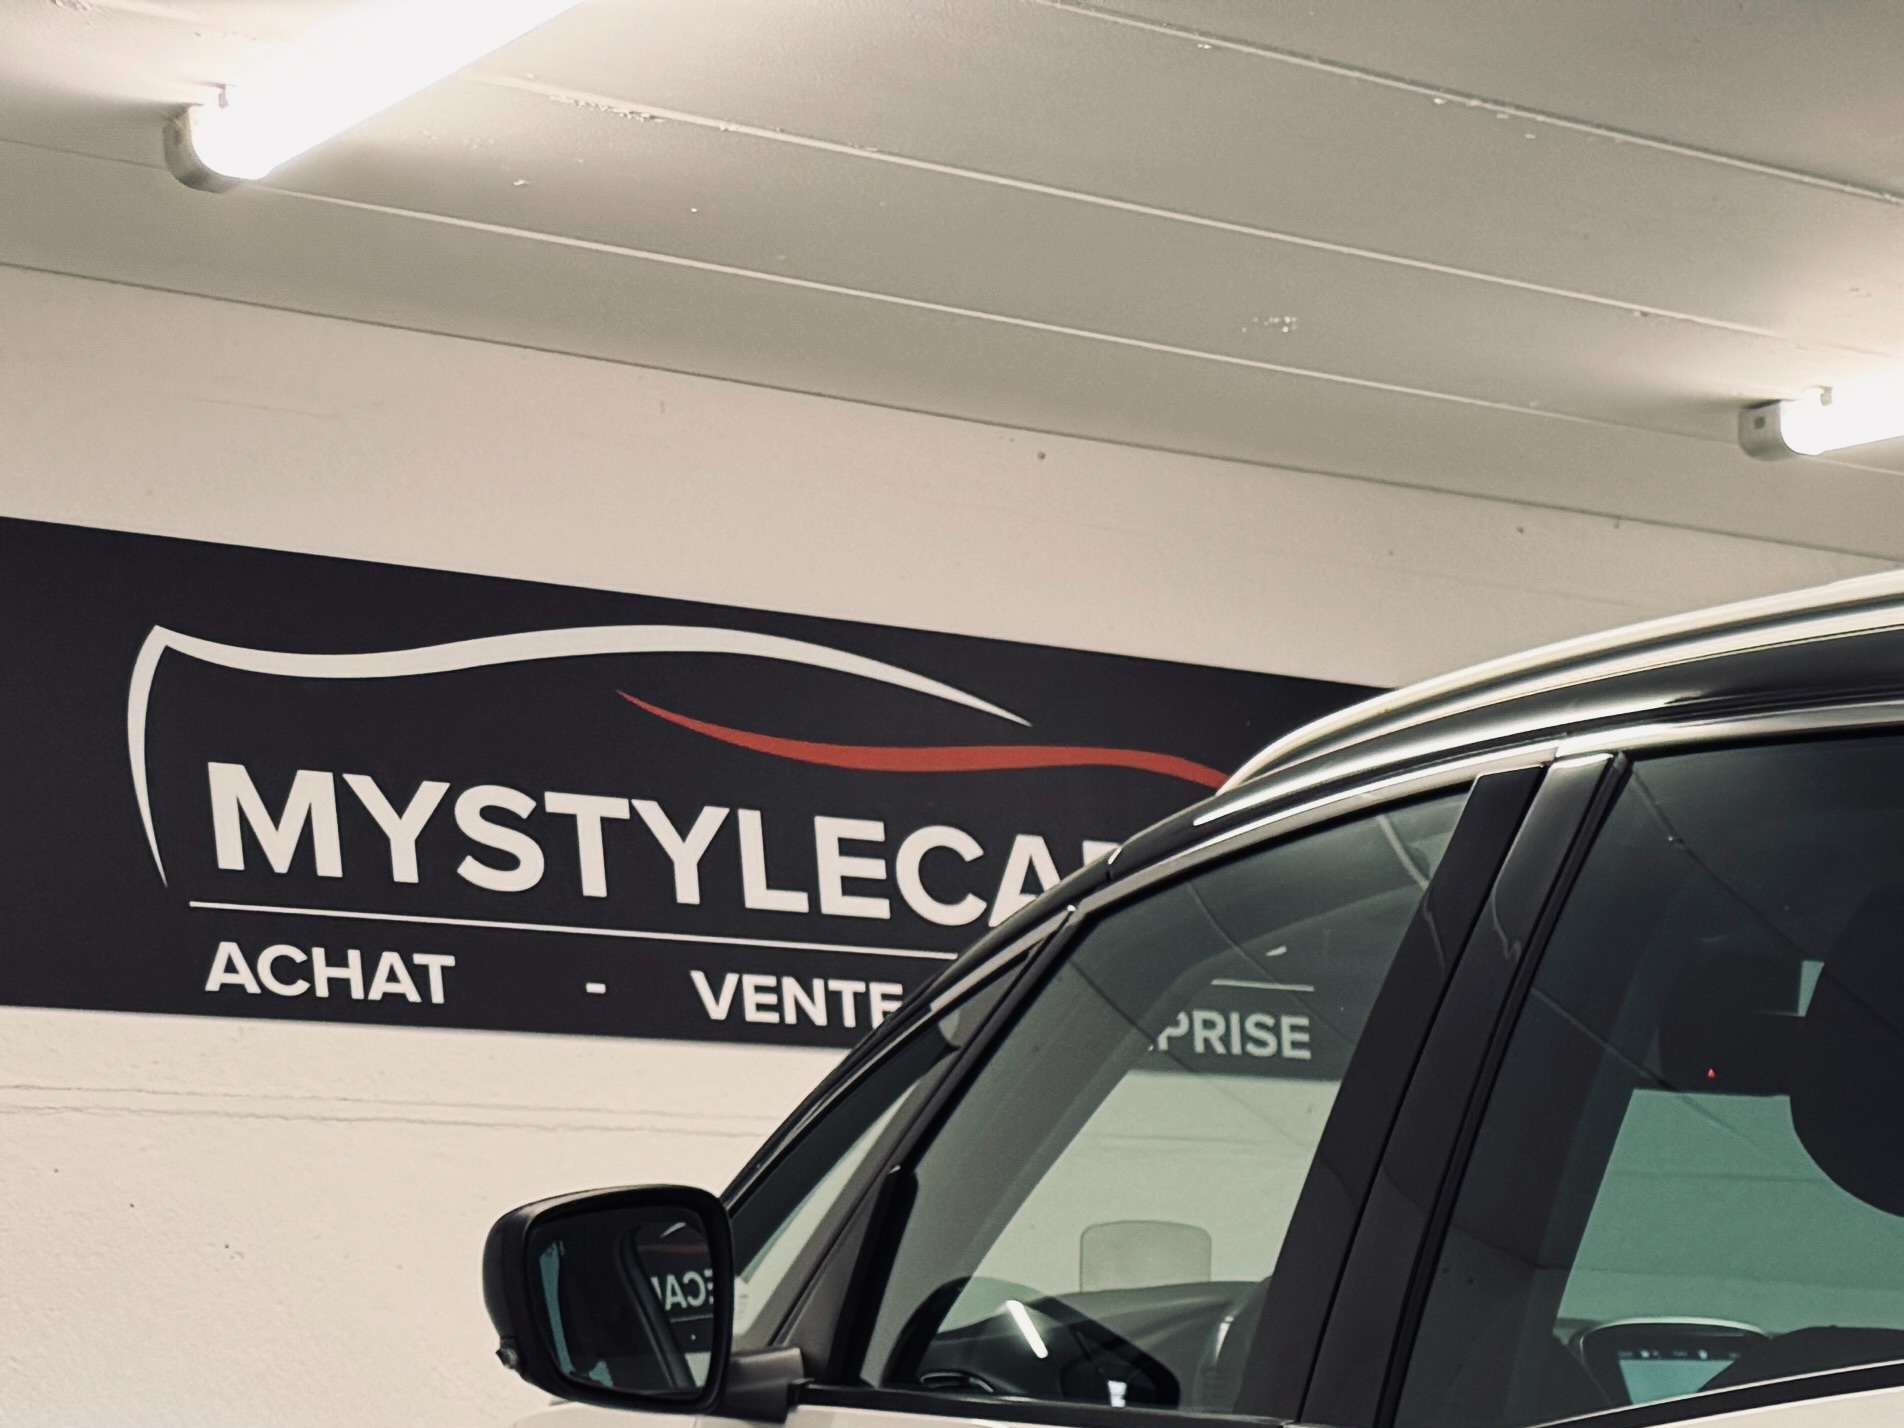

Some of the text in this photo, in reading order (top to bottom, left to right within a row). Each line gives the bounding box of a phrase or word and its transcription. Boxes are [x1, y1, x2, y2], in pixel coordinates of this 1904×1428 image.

[207, 761, 1123, 927] MYSTYLECA
[204, 941, 456, 1005] ACHAT
[1148, 1009, 1312, 1060] PRISE
